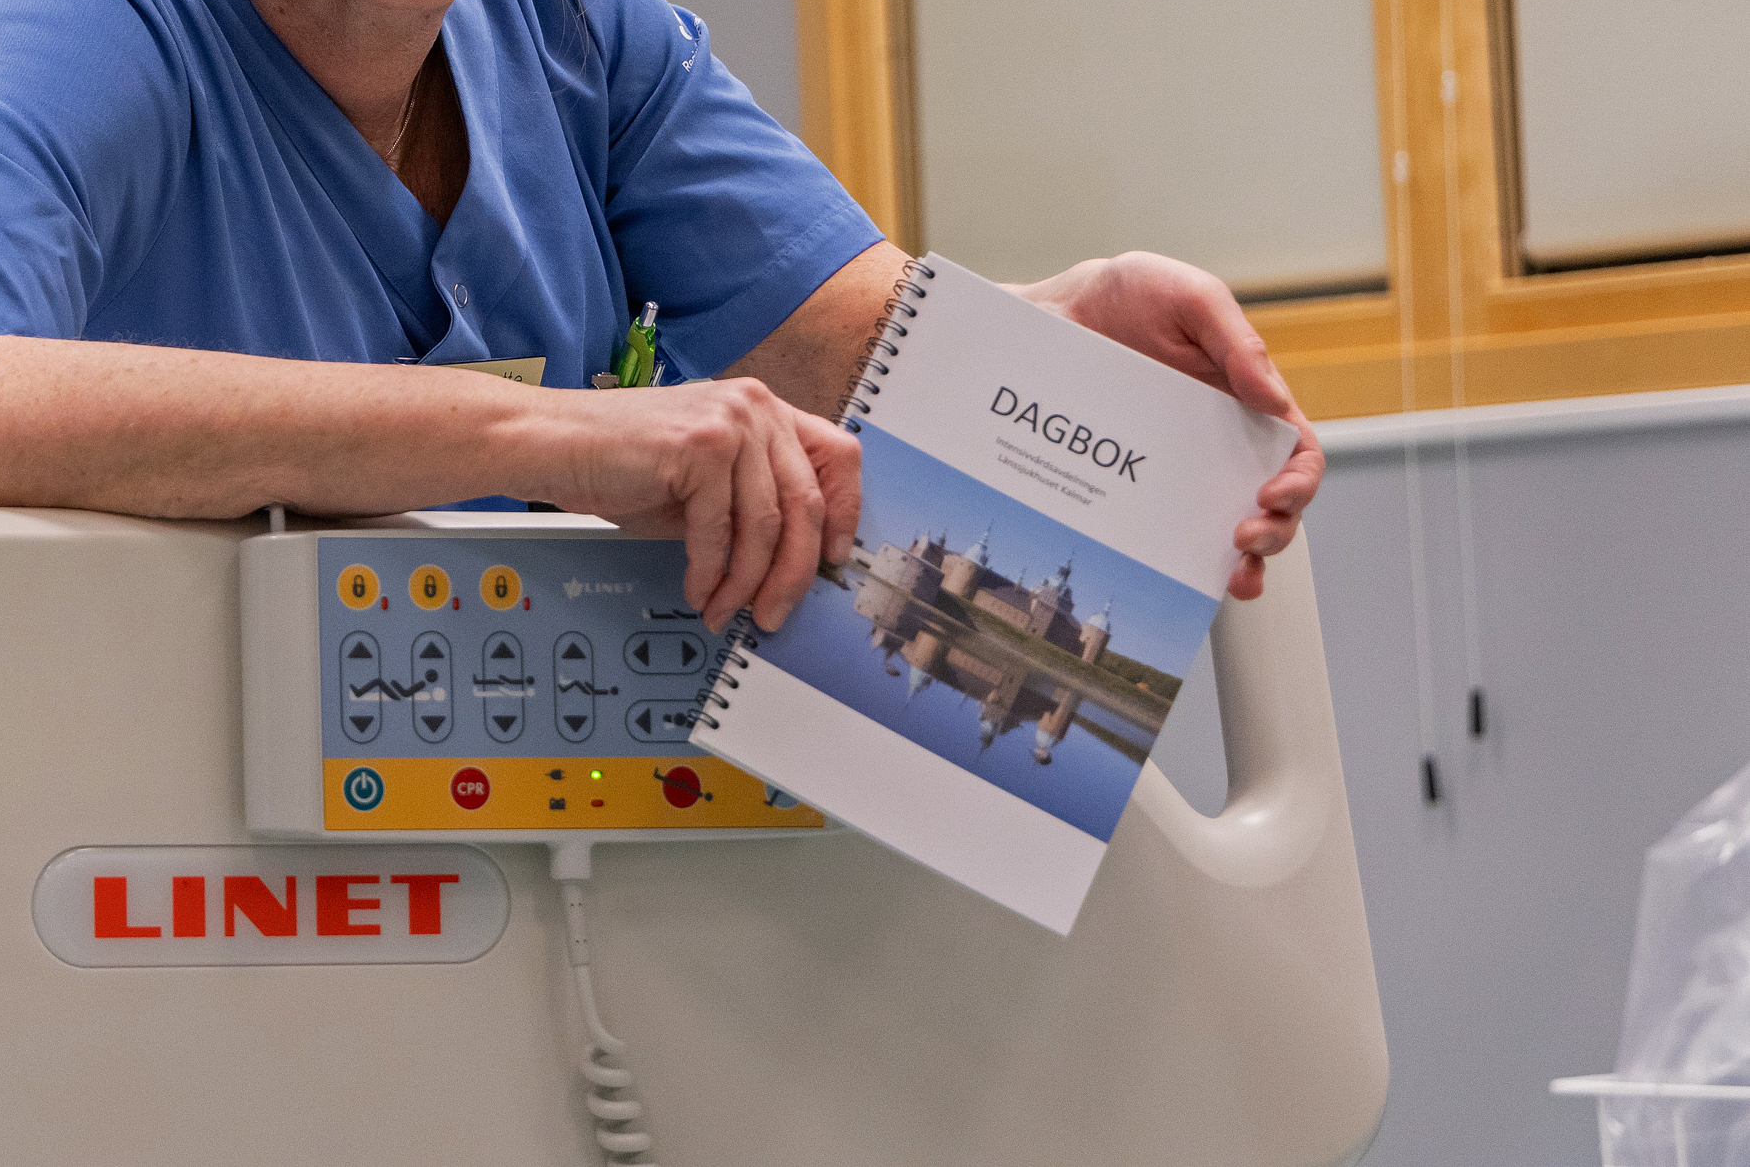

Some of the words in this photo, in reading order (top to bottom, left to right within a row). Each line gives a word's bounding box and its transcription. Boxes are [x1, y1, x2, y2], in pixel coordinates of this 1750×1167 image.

[990, 386, 1147, 482] DAGBOK
[996, 436, 1107, 497] Intensivvårdsavdelningen
[997, 454, 1059, 491] Länssjukhuset
[1060, 486, 1093, 505] Kalmar
[457, 781, 485, 796] CPR
[93, 873, 460, 938] LINET
